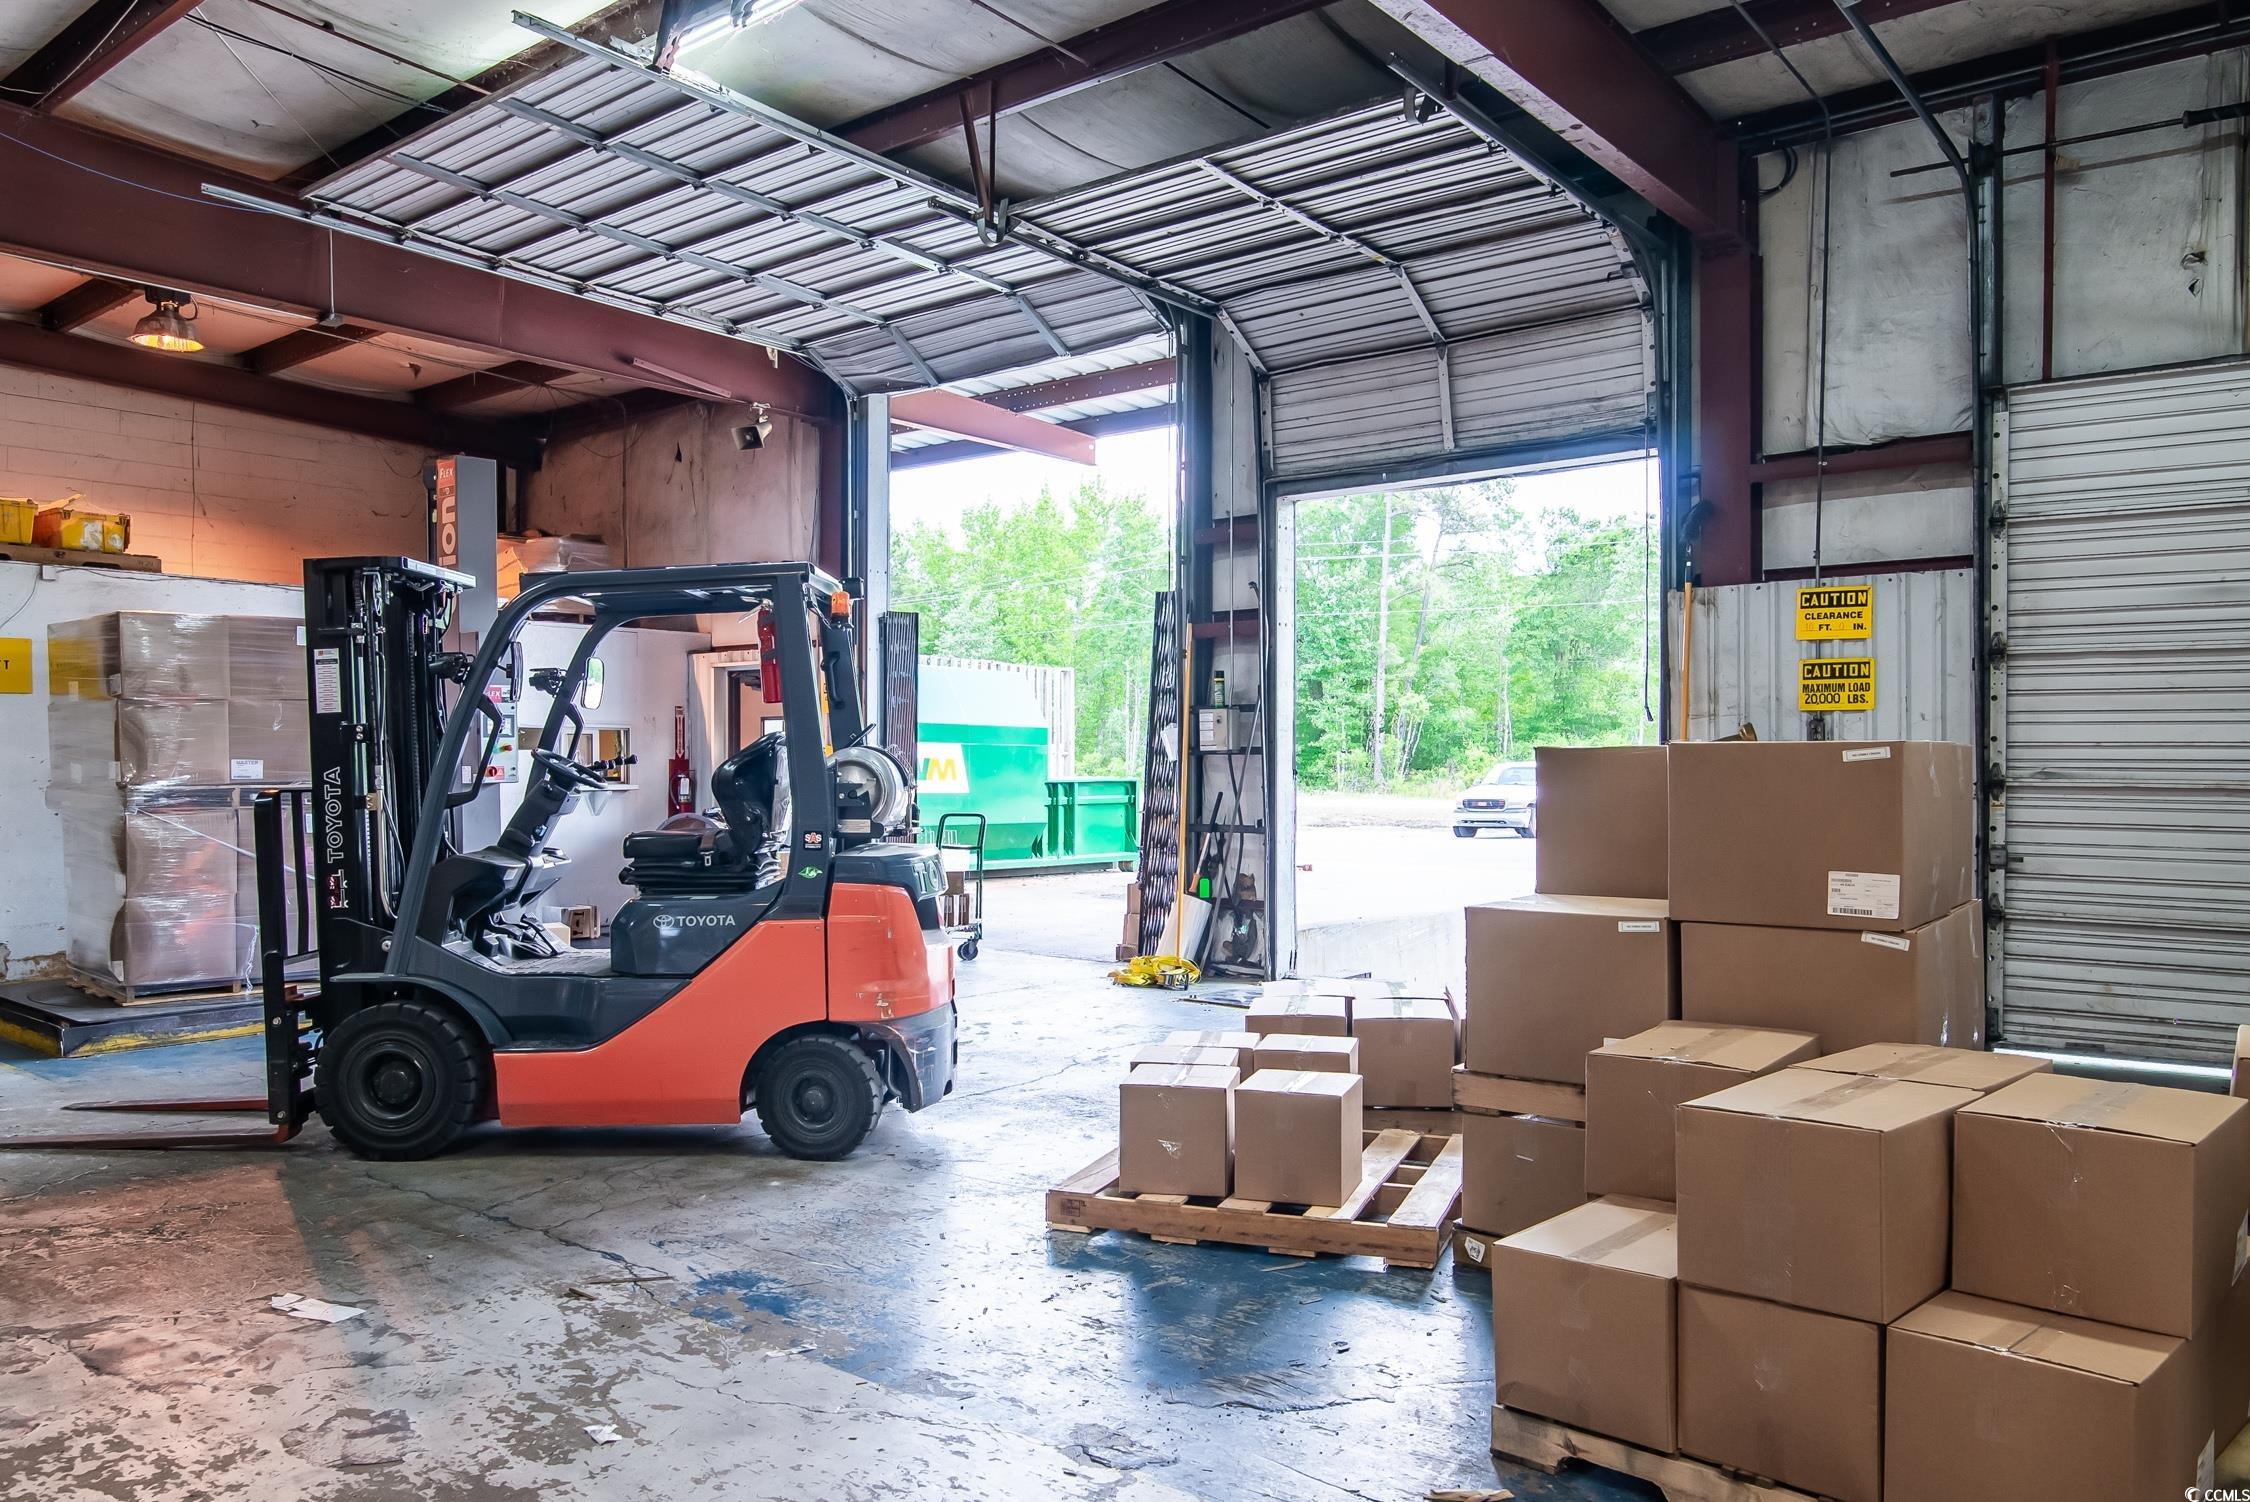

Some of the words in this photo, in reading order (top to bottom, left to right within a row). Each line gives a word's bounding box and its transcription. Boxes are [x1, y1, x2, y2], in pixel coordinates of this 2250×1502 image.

[438, 496, 457, 567] ion
[1801, 591, 1867, 607] CAUTION
[1804, 611, 1863, 620] CLEARANCE
[1818, 623, 1832, 631] FT.
[1853, 622, 1867, 630] IN.
[1804, 663, 1869, 678] CAUTION
[1802, 682, 1845, 693] MAXIMUM
[1848, 682, 1871, 692] LOAD
[1804, 693, 1841, 705] 20,000
[1847, 693, 1869, 704] LBS.
[324, 766, 344, 864] TOYOTA
[804, 832, 822, 844] SAS
[676, 914, 736, 927] TOYOTA
